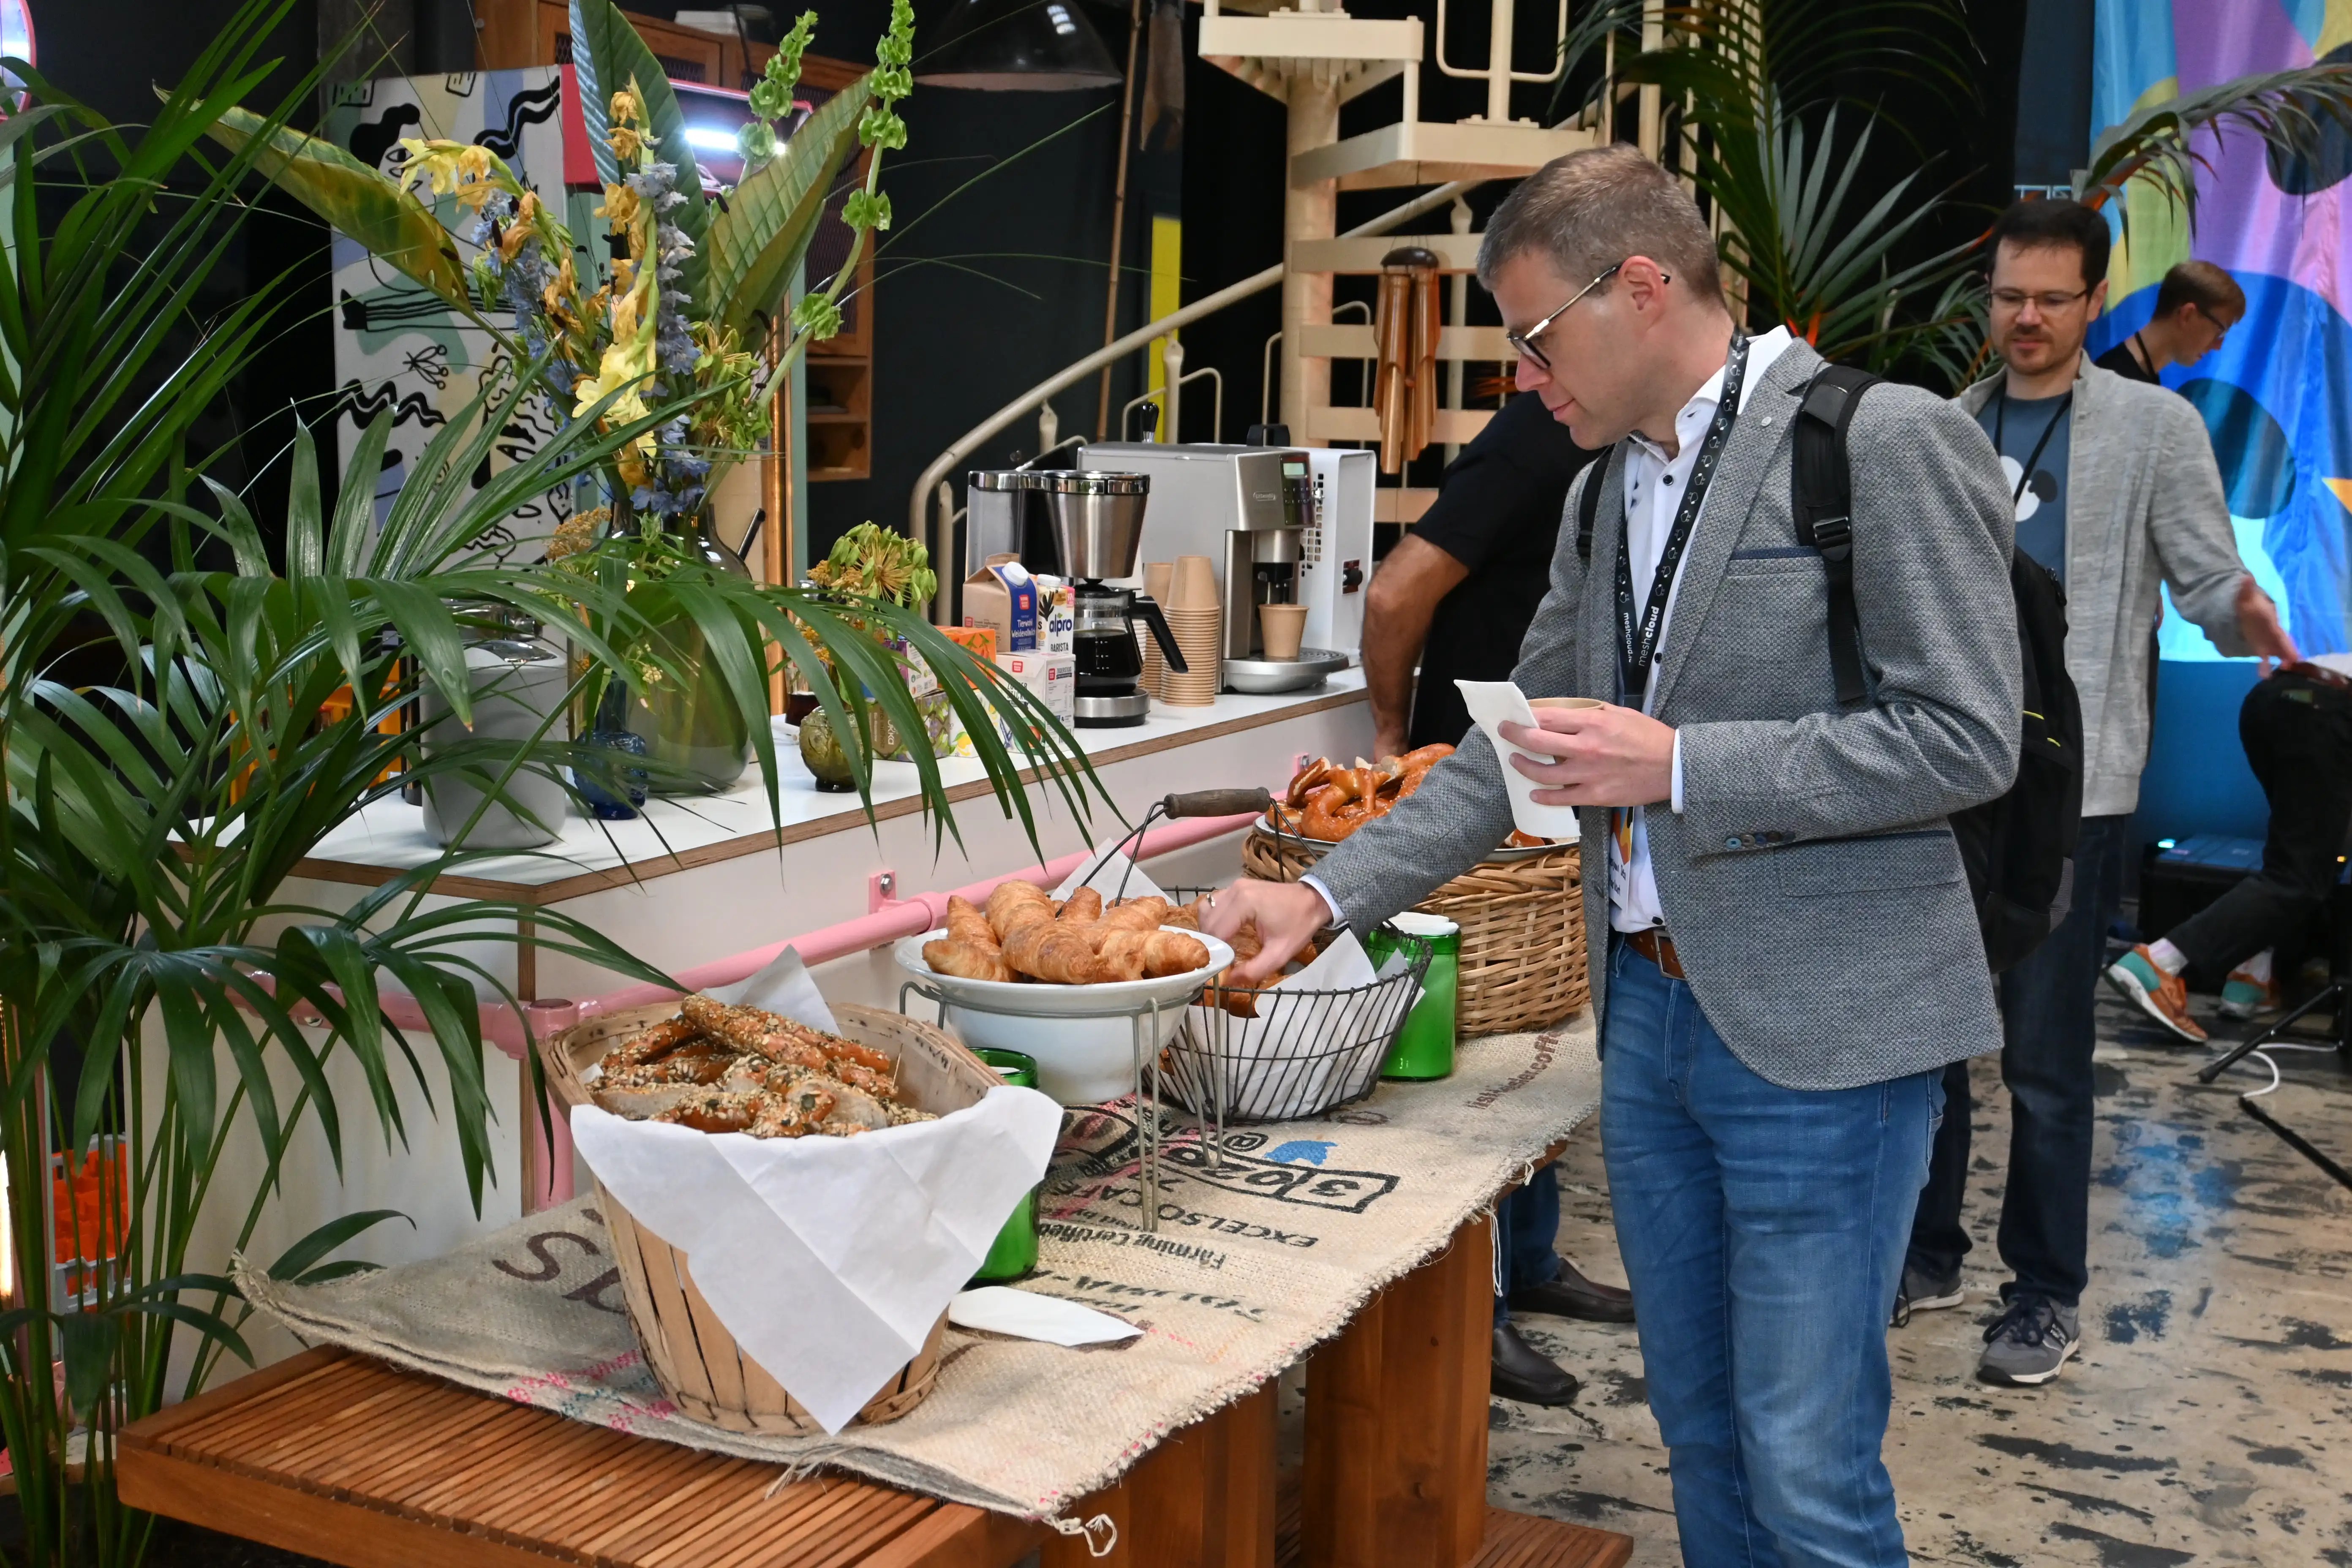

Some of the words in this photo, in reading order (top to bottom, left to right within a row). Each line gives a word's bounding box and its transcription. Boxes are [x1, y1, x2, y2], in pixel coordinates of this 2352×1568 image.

[1049, 614, 1073, 637] alpro
[1638, 605, 1660, 667] meshcloud
[1051, 642, 1069, 653] BARISTA
[1308, 1180, 1360, 1198] 3
[1157, 1204, 1318, 1247] EXCELSO
[1134, 1230, 1228, 1269] Farming
